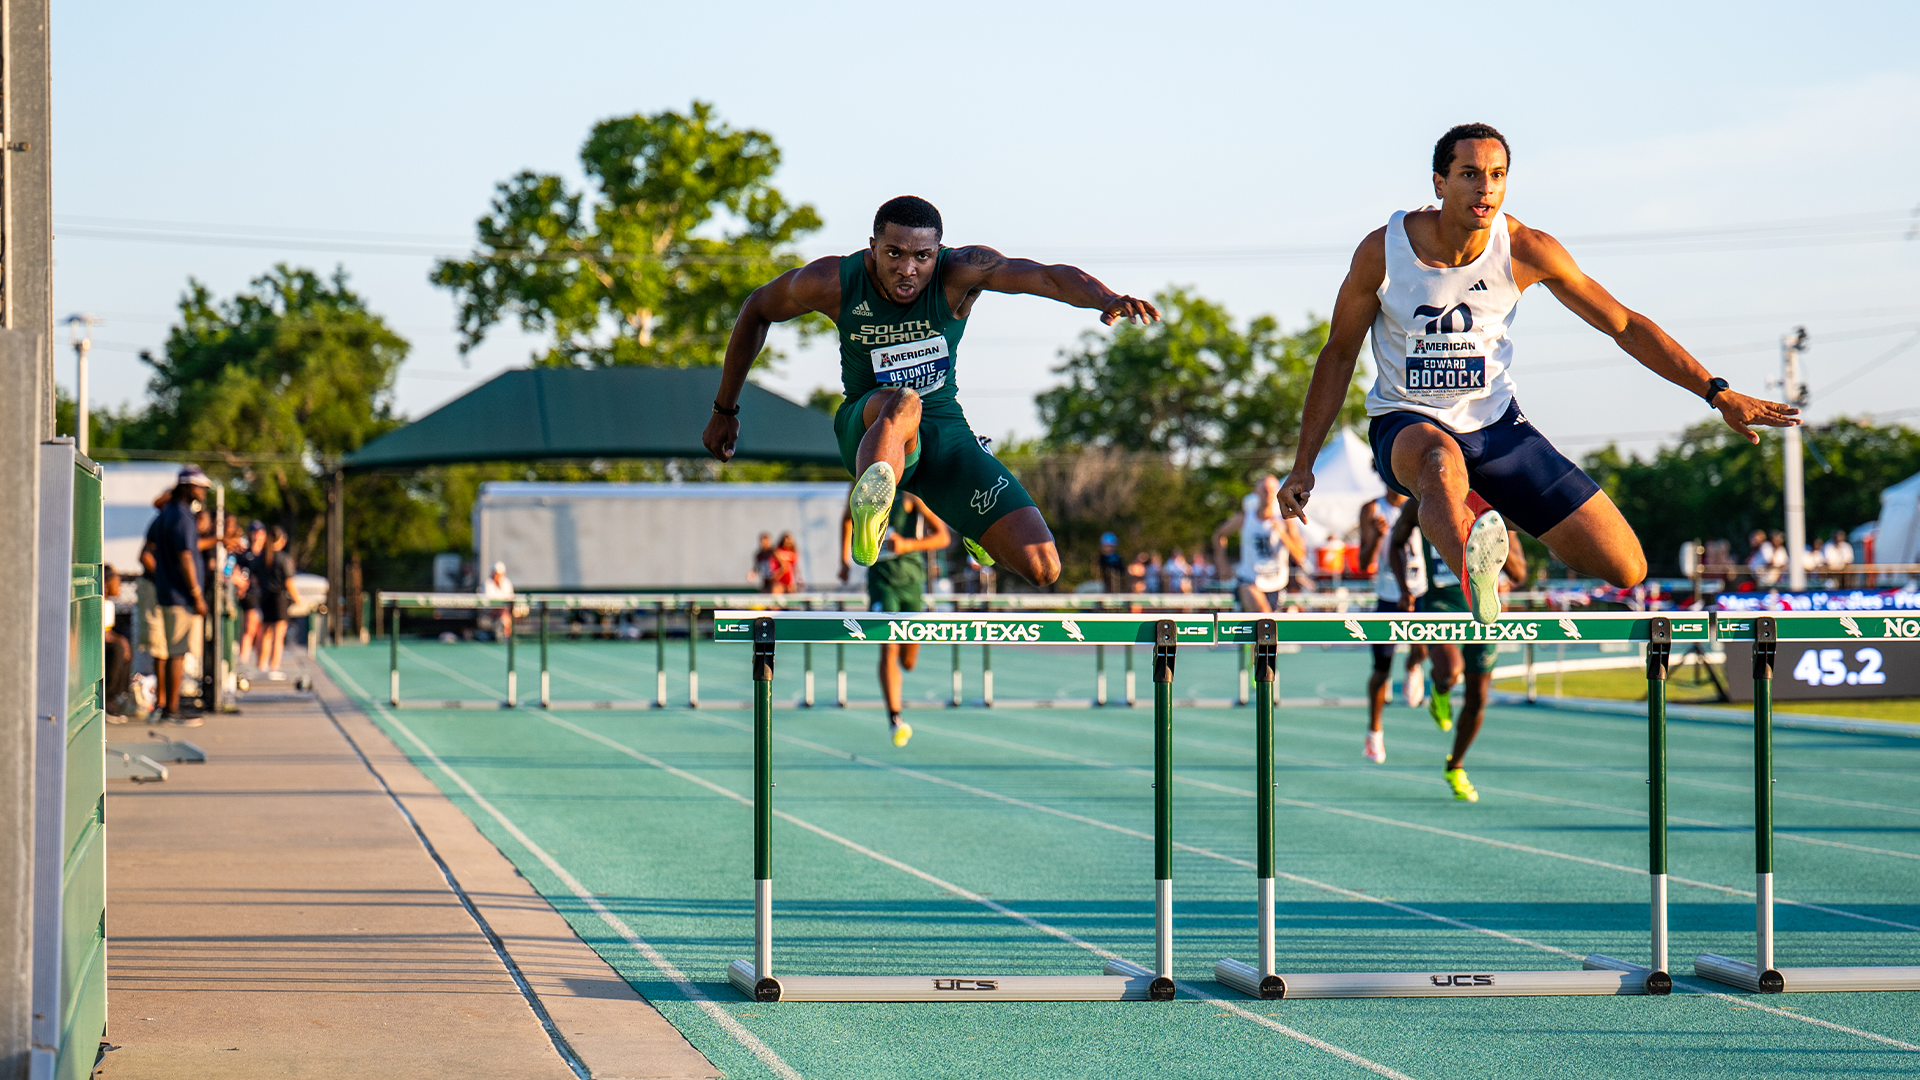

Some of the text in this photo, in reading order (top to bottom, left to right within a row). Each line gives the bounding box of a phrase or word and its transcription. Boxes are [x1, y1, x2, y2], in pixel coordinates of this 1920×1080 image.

[852, 309, 874, 317] adidas
[860, 320, 931, 335] SOUTH
[850, 329, 941, 345] FLORIDA
[1413, 339, 1476, 354] AMERICAN
[880, 346, 940, 368] AMERICAN
[1424, 359, 1466, 369] EDWARD
[890, 362, 937, 382] DEVONTIE
[1410, 370, 1481, 388] BOCOCK
[717, 624, 750, 633] UCS
[888, 620, 1040, 641] NORTH TEXAS
[1176, 626, 1208, 635] UCS
[1221, 626, 1253, 635] UCS
[1388, 620, 1539, 641] NORTH TEXAS
[1670, 622, 1703, 633] UCS
[1718, 622, 1750, 632] UCS
[1793, 647, 1886, 686] 45.2
[932, 979, 998, 990] UCS
[1430, 975, 1495, 986] UCS
